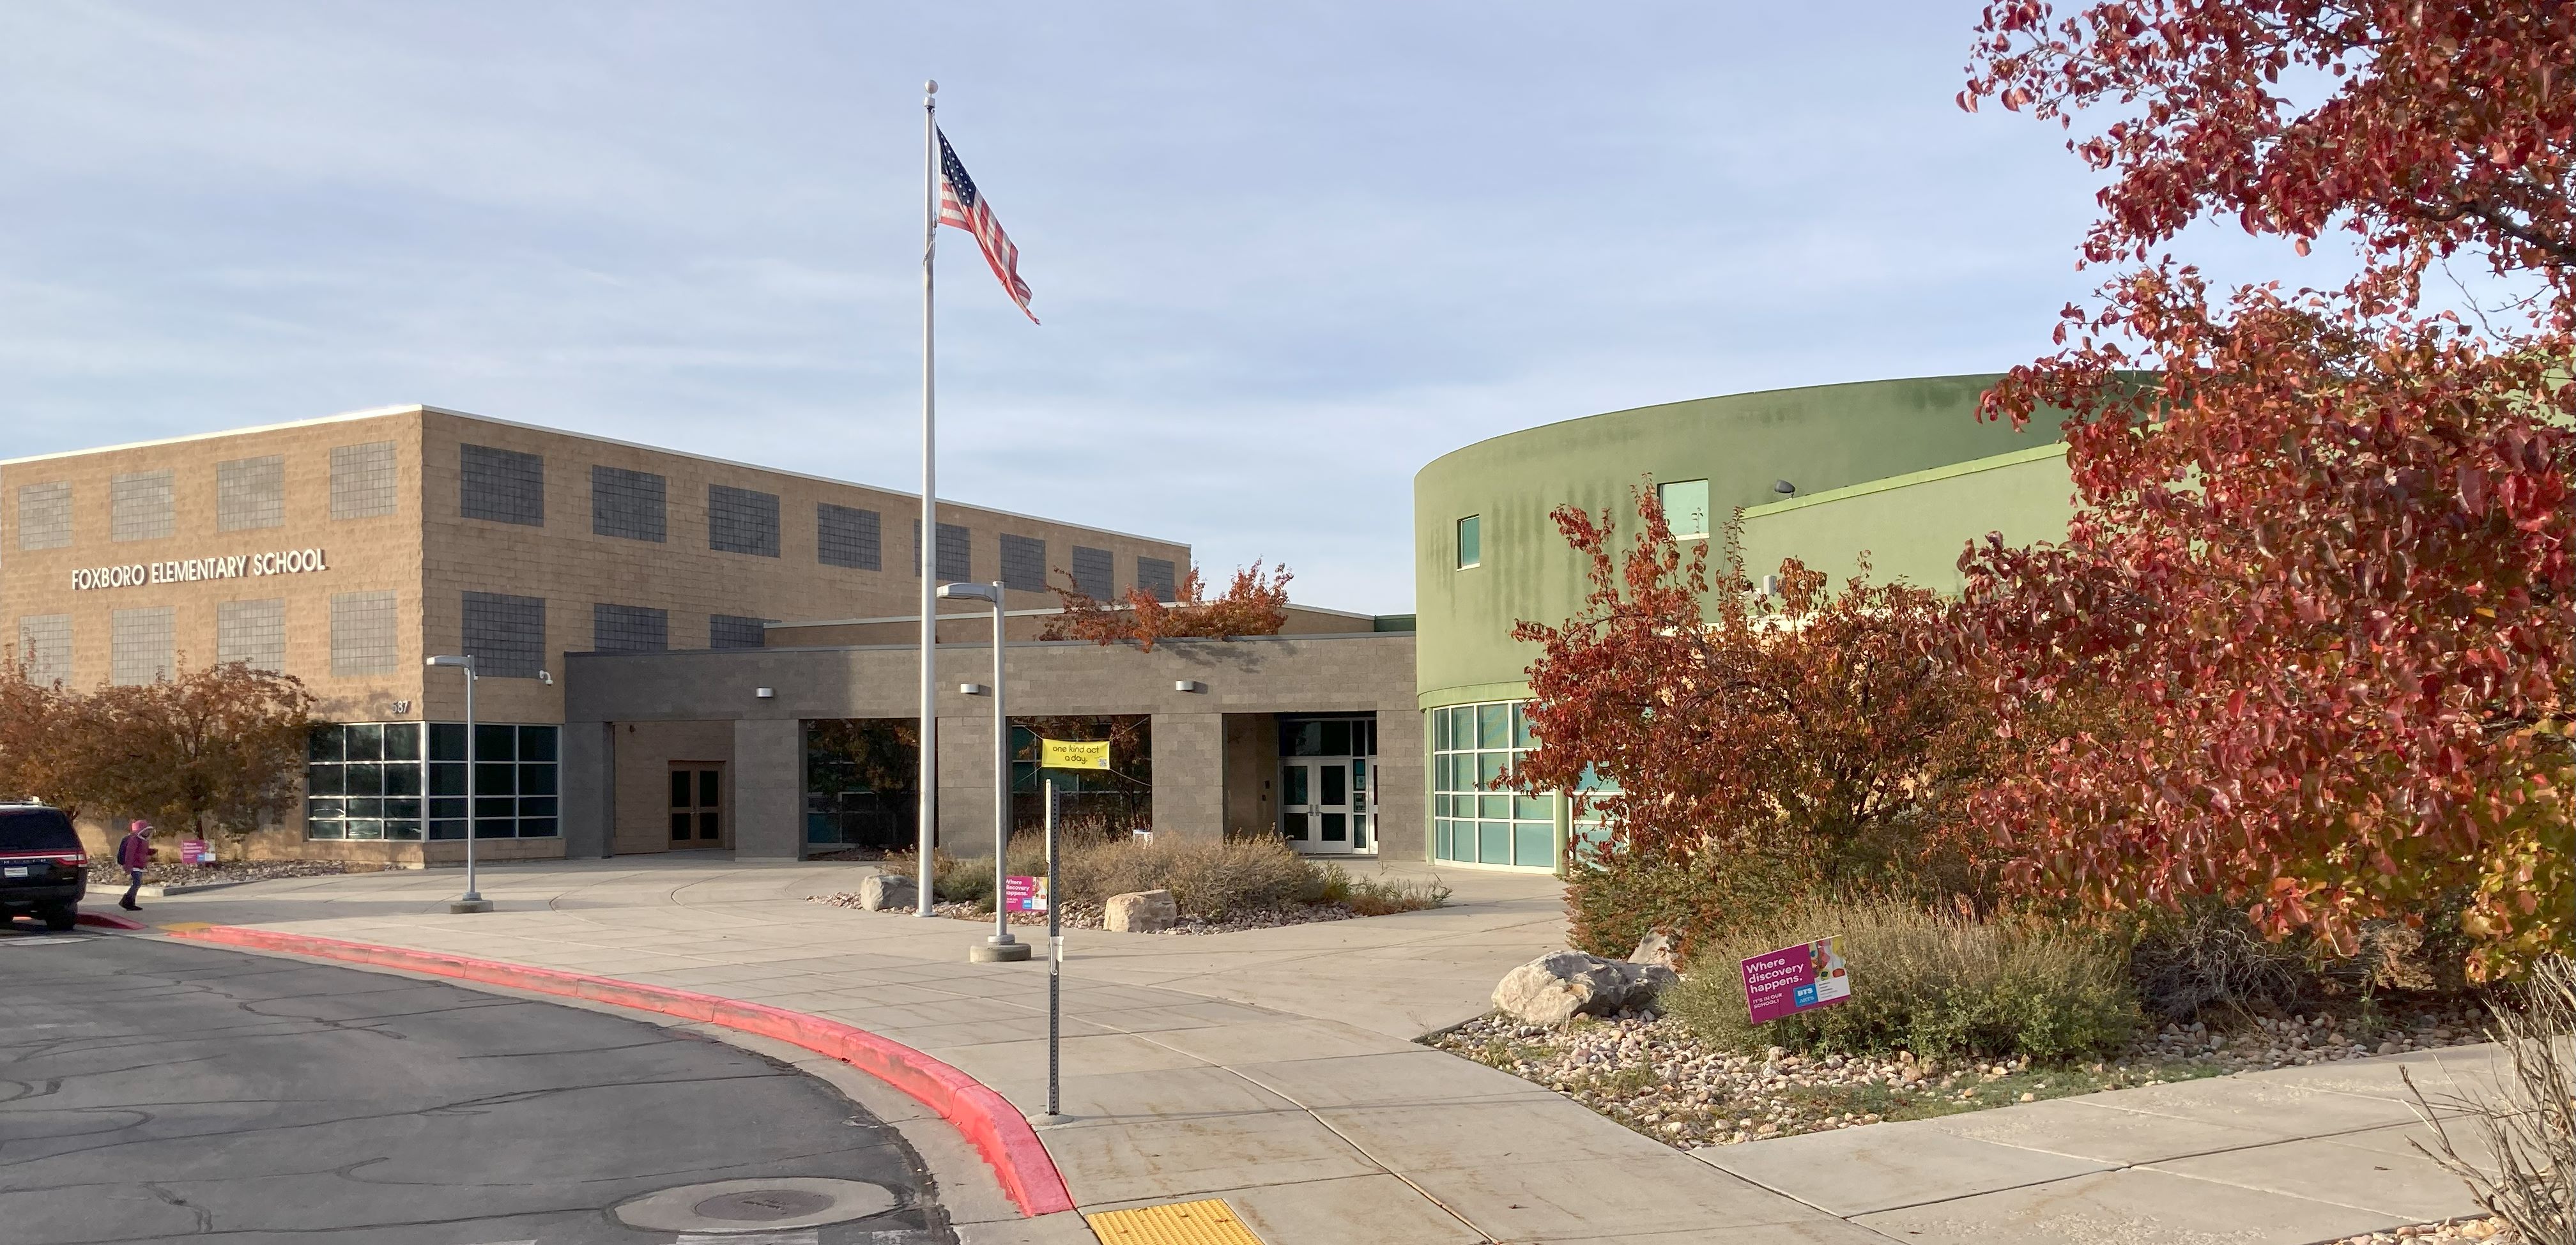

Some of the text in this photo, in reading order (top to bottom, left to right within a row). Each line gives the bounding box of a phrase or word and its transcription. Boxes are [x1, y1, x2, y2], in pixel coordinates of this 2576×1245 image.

[72, 548, 325, 590] FOXBORO ELEMENTARY SCHOOL
[1069, 745, 1085, 753] kind
[1745, 958, 1785, 974] Where
[1749, 963, 1804, 983] discovery
[1750, 975, 1803, 994] happens.
[1797, 988, 1813, 997] BTS
[1754, 999, 1780, 1009] SCHOOL!
